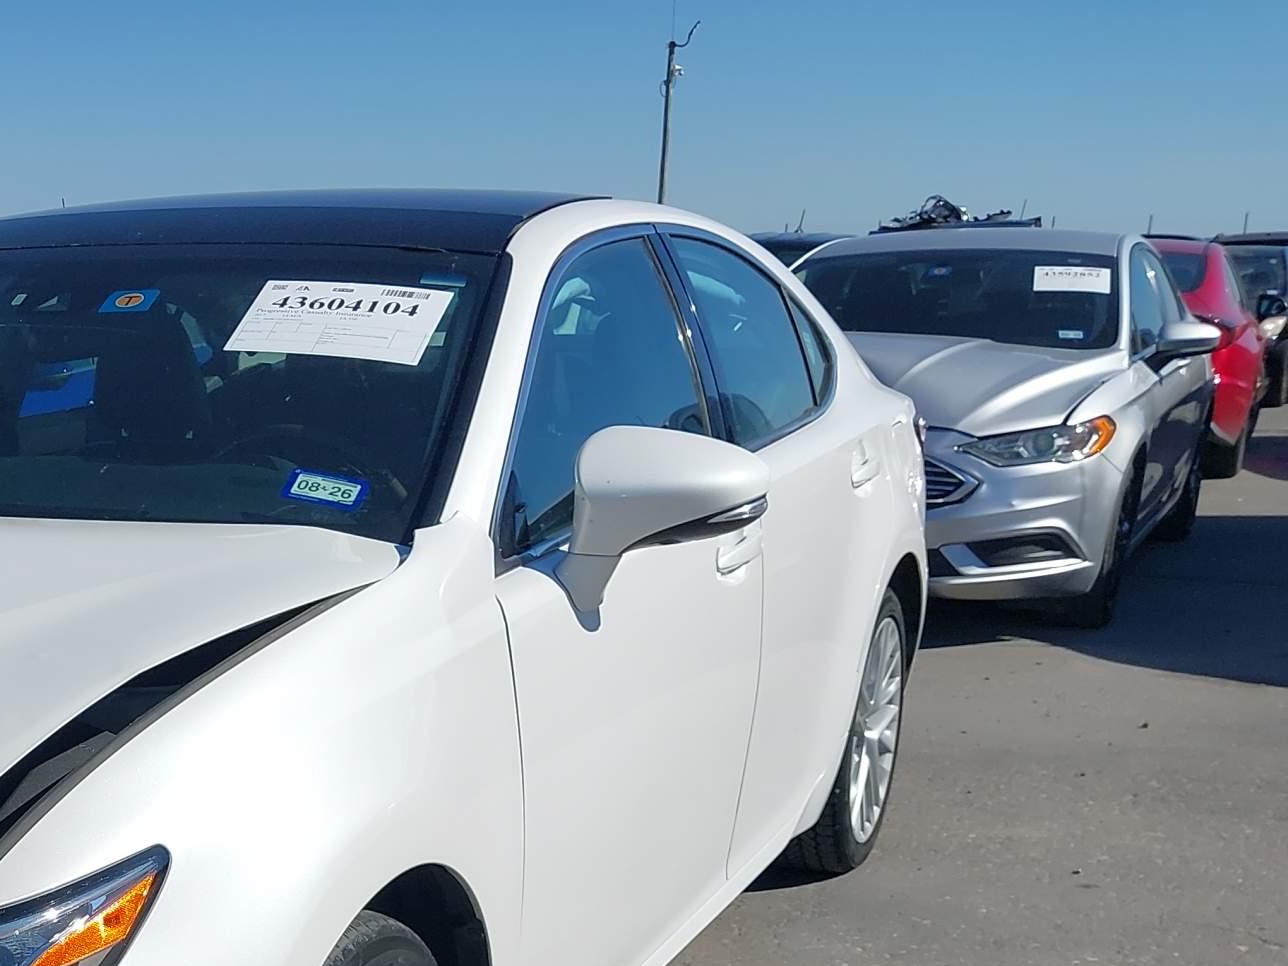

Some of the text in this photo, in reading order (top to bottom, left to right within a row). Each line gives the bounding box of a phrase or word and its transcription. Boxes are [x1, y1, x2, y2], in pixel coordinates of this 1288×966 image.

[272, 296, 420, 317] 43604104
[297, 479, 354, 500] 08 26
